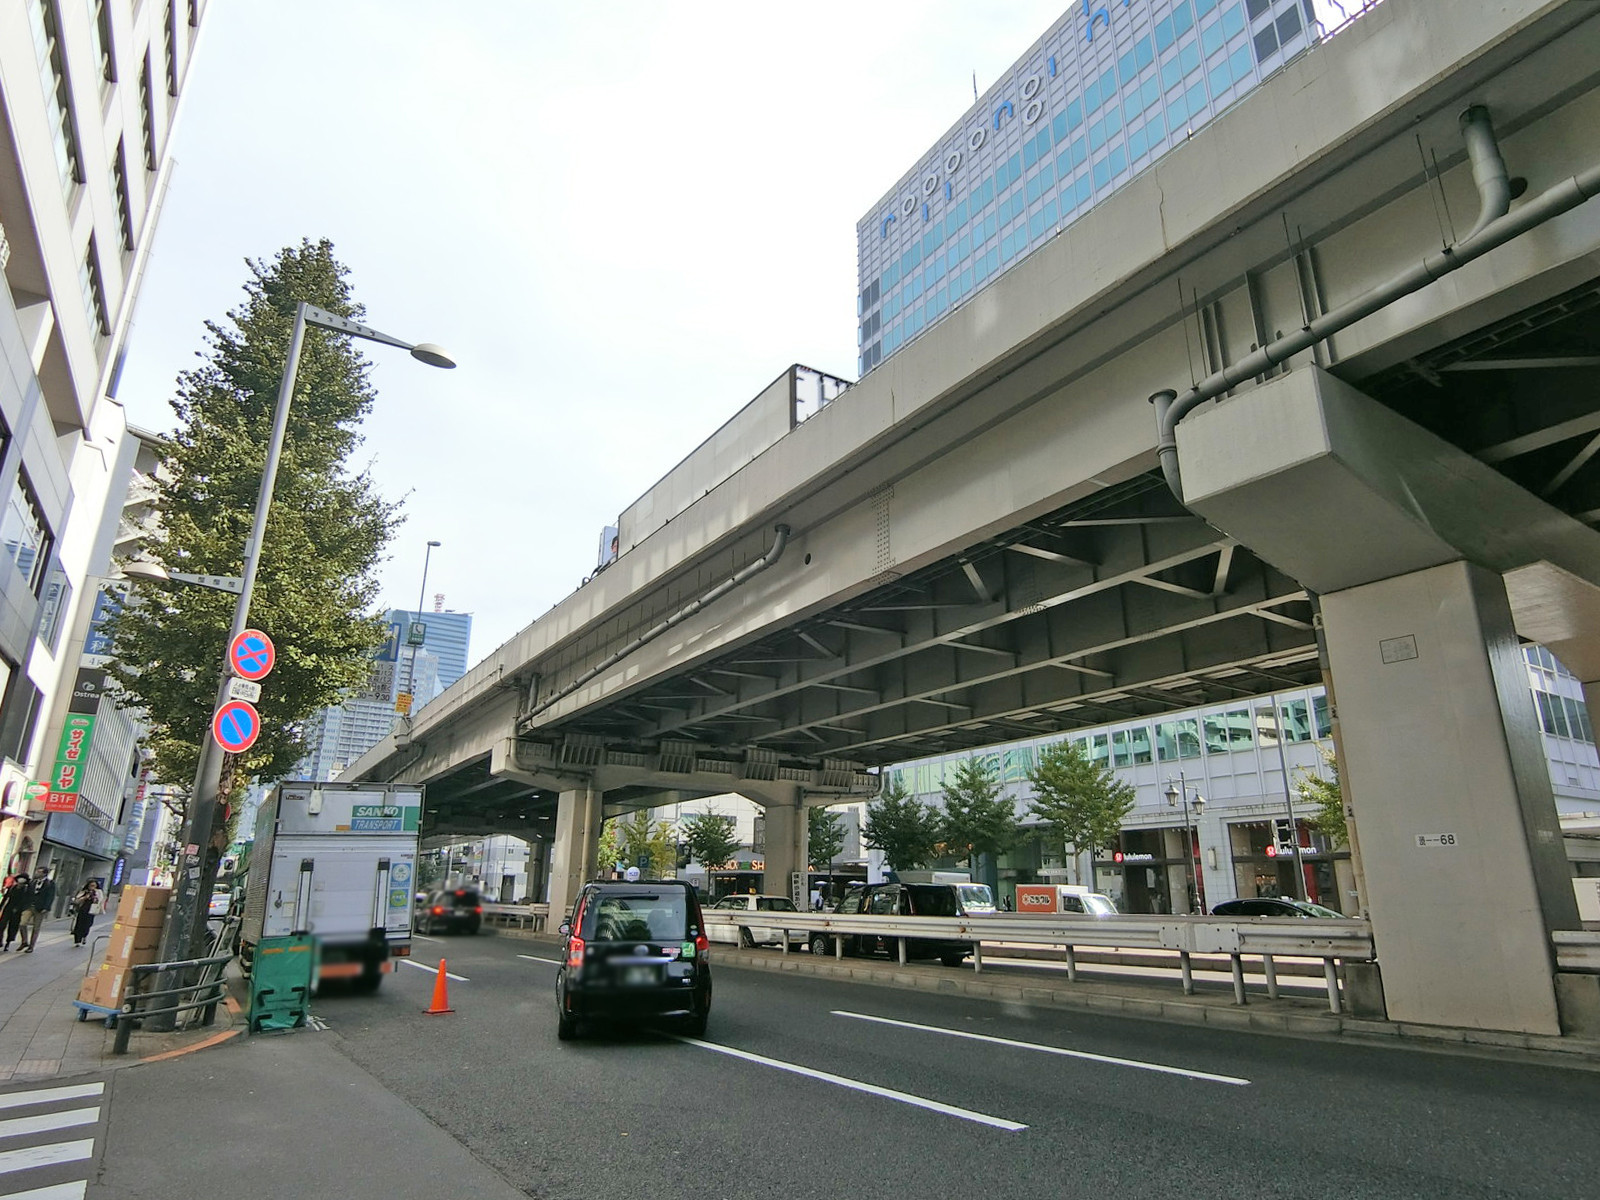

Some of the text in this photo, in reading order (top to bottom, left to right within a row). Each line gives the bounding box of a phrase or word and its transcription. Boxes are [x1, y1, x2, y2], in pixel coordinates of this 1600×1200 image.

[74, 690, 100, 699] Ostrea
[59, 729, 84, 789] サイゼリヤ
[49, 793, 74, 804] B1F
[356, 806, 400, 817] SANKO
[354, 820, 399, 830] TRANSPORT
